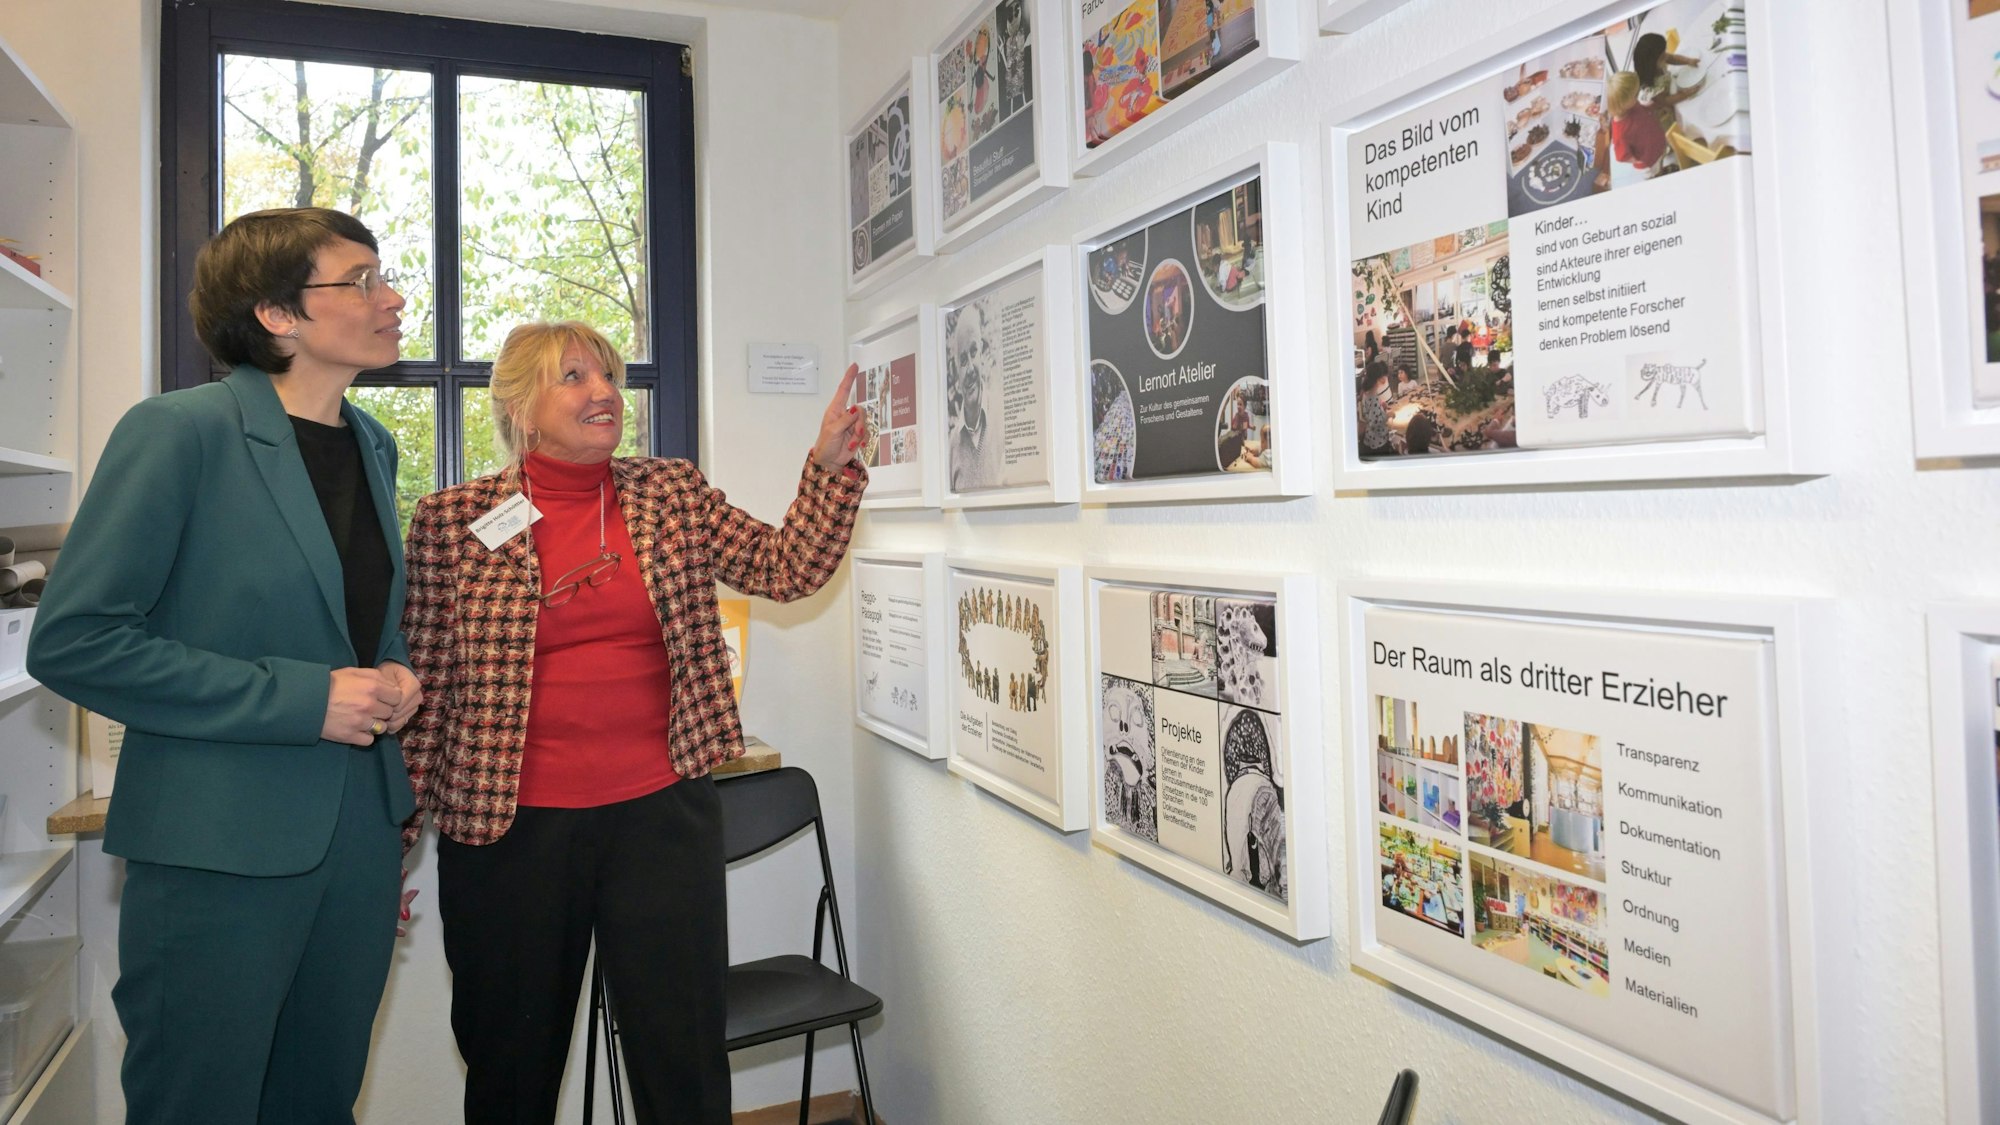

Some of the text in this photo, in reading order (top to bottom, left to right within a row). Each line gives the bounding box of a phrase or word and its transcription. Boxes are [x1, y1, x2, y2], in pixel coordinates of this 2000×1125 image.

[1365, 107, 1479, 165] Das Bild vom
[1366, 140, 1478, 194] kompetenten
[1367, 192, 1402, 223] Kind
[1536, 211, 1677, 256] sind von Geburt an sozial
[1537, 234, 1683, 276] sind Akteure ihrer eigenen
[1537, 269, 1601, 292] Entwicklung
[1538, 280, 1647, 311] lernen selbst initiiert
[1539, 296, 1686, 331] sind kompetente Forscher
[1539, 319, 1671, 351] denken Problem lösend
[1139, 361, 1217, 393] Lernort Atelier
[1140, 395, 1210, 414] Zur Kultur des gemeinsamen
[1140, 408, 1203, 424] Forschens und Gestaltens
[1373, 641, 1728, 719] Der Raum als dritter Erzieher
[1161, 717, 1202, 744] Projekte
[1161, 746, 1188, 764] Orientierung
[1196, 757, 1206, 767] den
[1161, 754, 1204, 775] Themen der Kinder
[1161, 765, 1177, 776] Lernen
[1616, 742, 1700, 773] Transparenz
[1161, 782, 1184, 798] Umsetzen
[1199, 795, 1208, 807] 100
[1162, 791, 1184, 806] Sprachen
[1618, 781, 1723, 819] Kommunikation
[1162, 801, 1197, 822] Dokumentieren
[1619, 820, 1721, 860] Dokumentation
[1621, 860, 1672, 887] Struktur
[1622, 899, 1680, 933] Ordnung
[1624, 937, 1672, 967] Medien
[1625, 976, 1698, 1019] Materialien
